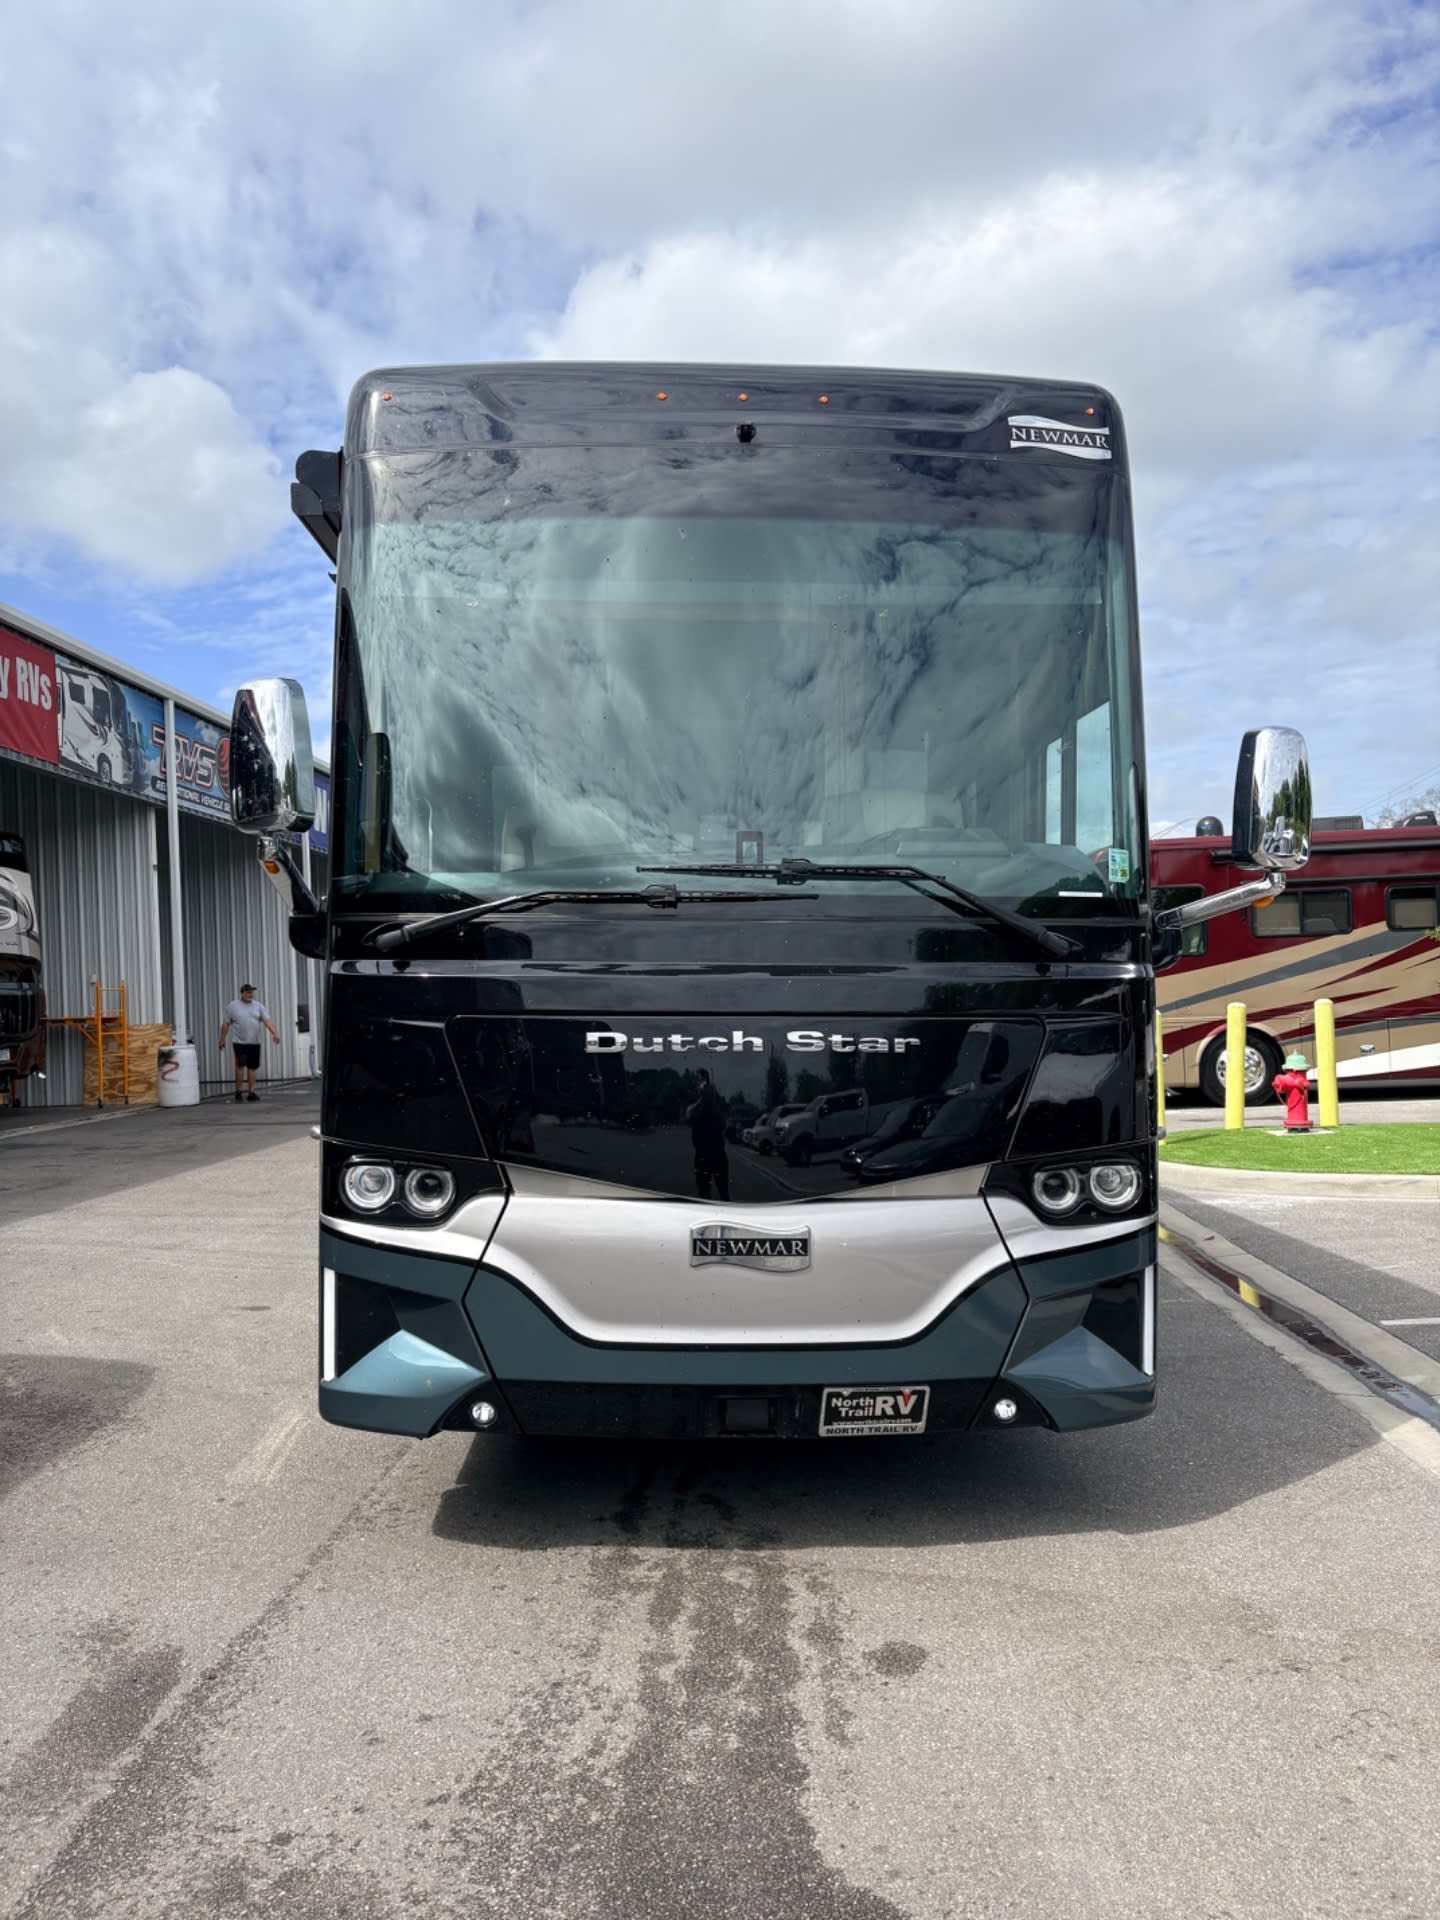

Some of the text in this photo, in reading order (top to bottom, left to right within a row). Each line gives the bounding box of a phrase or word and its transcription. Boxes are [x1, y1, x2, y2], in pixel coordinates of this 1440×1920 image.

[1010, 427, 1109, 448] NEWMAR
[584, 1030, 920, 1053] Dutch Star
[695, 1240, 807, 1256] NEWMAR
[831, 1396, 874, 1407] North
[874, 1395, 918, 1416] RV
[838, 1407, 873, 1416] Trail
